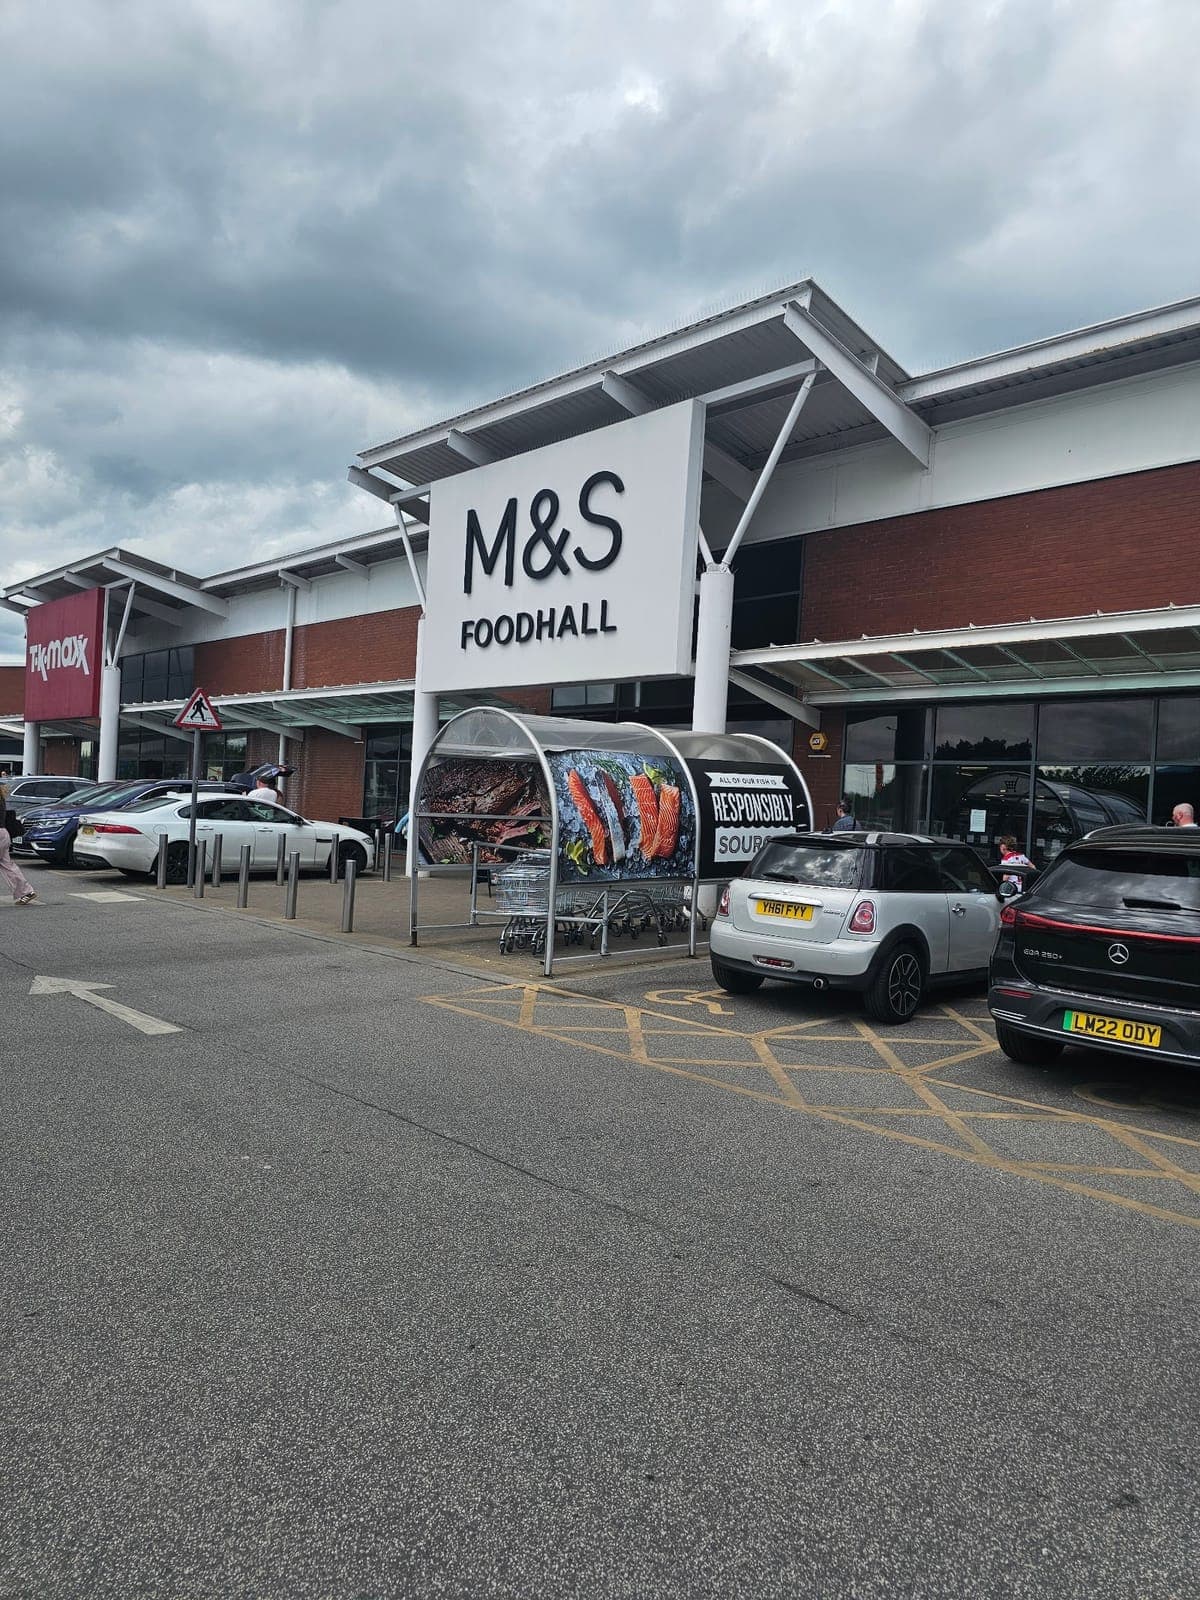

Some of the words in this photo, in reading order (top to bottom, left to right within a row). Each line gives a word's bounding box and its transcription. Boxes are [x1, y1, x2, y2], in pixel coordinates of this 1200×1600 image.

[464, 471, 625, 594] M&S
[461, 600, 617, 650] FOODHALL
[742, 777, 755, 785] OUR
[711, 793, 793, 821] RESPONSIBLY
[763, 901, 784, 915] YH61
[785, 904, 807, 917] FYY
[1023, 948, 1040, 957] EQA
[1074, 1015, 1118, 1036] LM22
